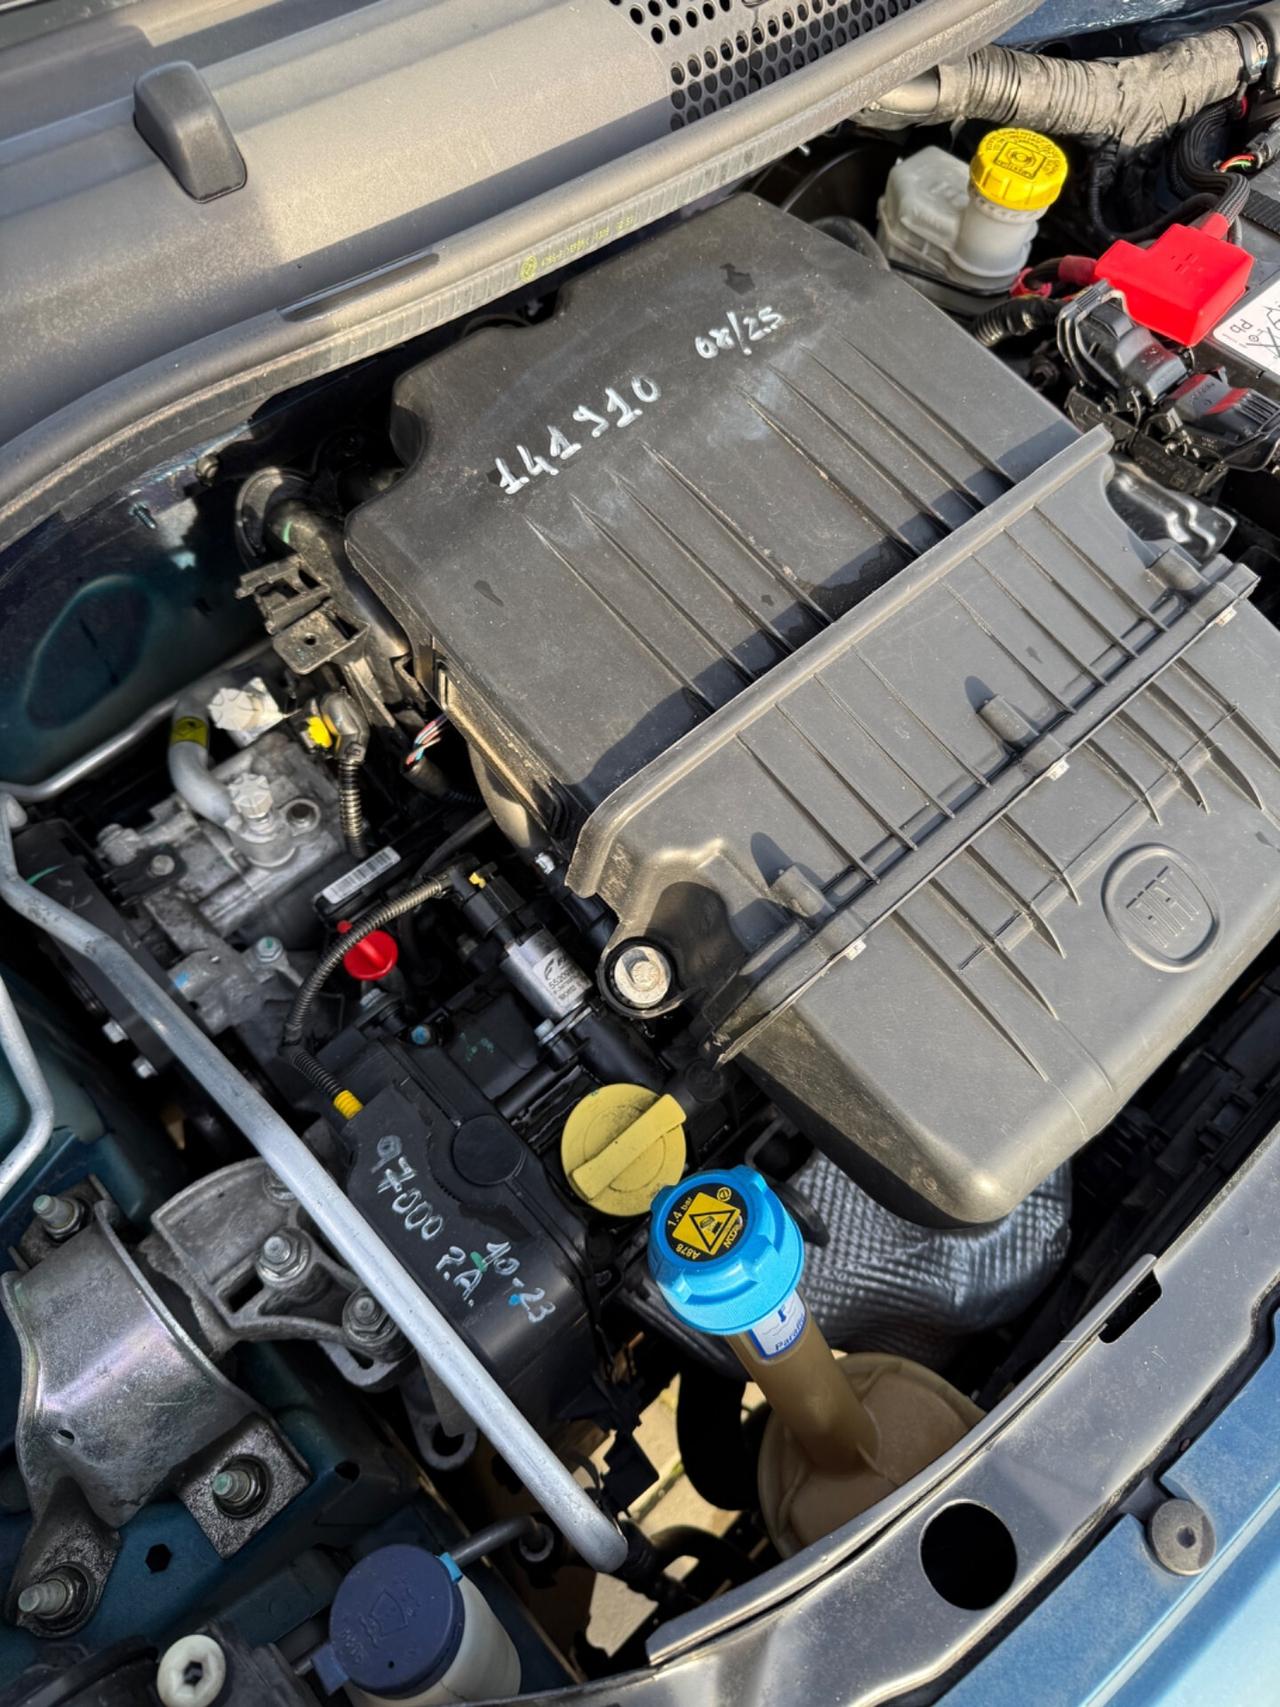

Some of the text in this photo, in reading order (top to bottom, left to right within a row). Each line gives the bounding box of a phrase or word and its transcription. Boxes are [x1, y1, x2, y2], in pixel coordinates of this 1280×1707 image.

[1230, 319, 1253, 334] Pb
[495, 375, 660, 494] 141910
[668, 1211, 682, 1227] 1.4
